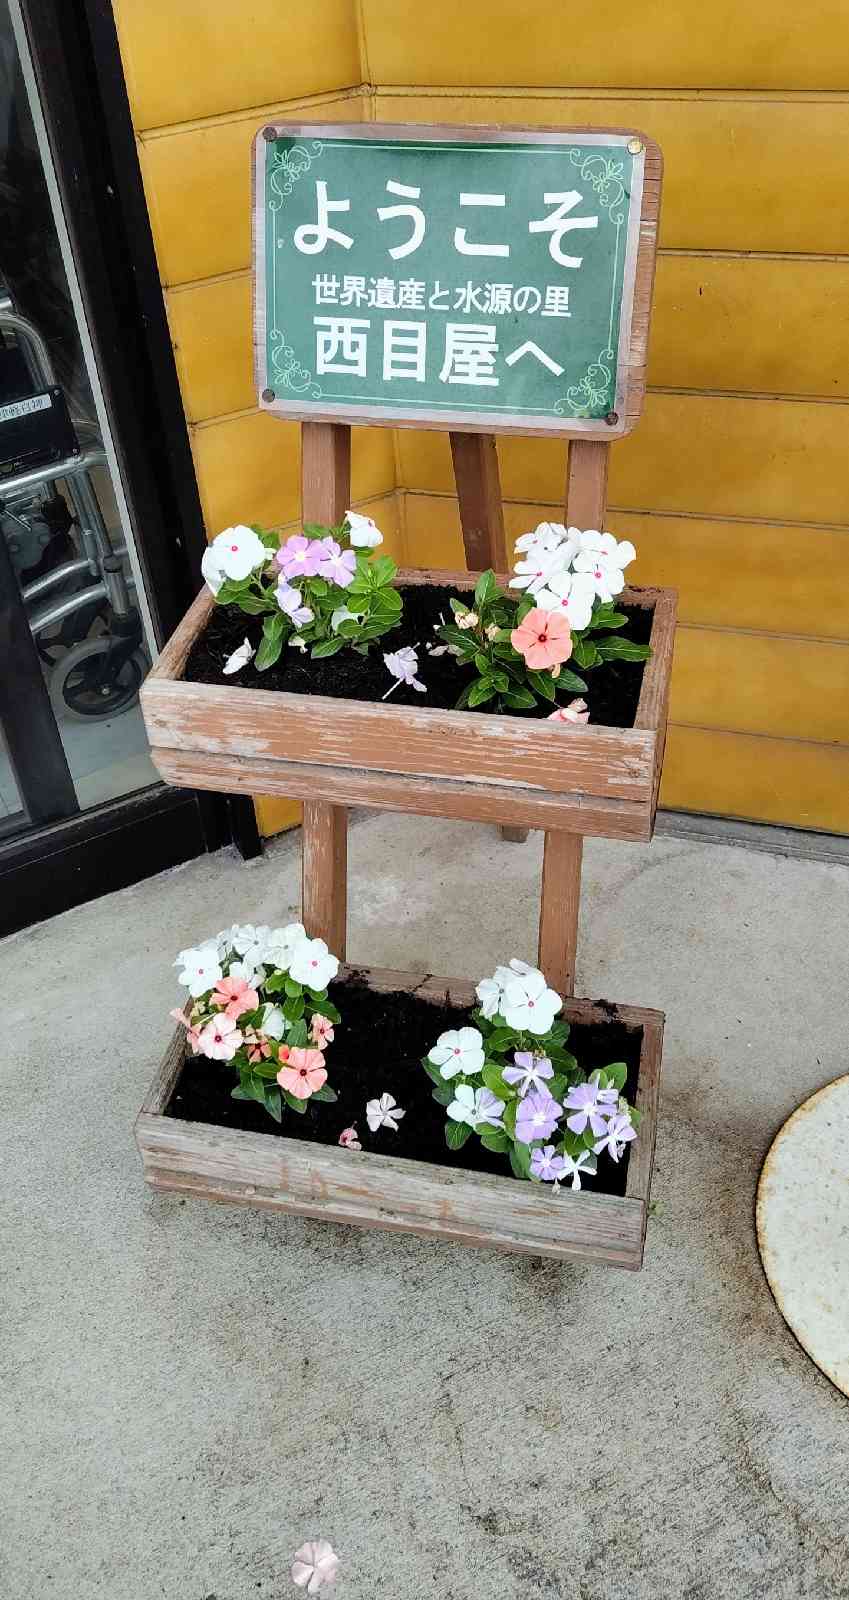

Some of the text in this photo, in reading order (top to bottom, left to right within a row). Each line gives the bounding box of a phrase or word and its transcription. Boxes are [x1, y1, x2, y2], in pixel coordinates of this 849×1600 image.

[293, 180, 598, 269] ようこそ
[311, 274, 572, 317] 世界遺産と水源の里
[313, 316, 564, 387] 西目屋へ
